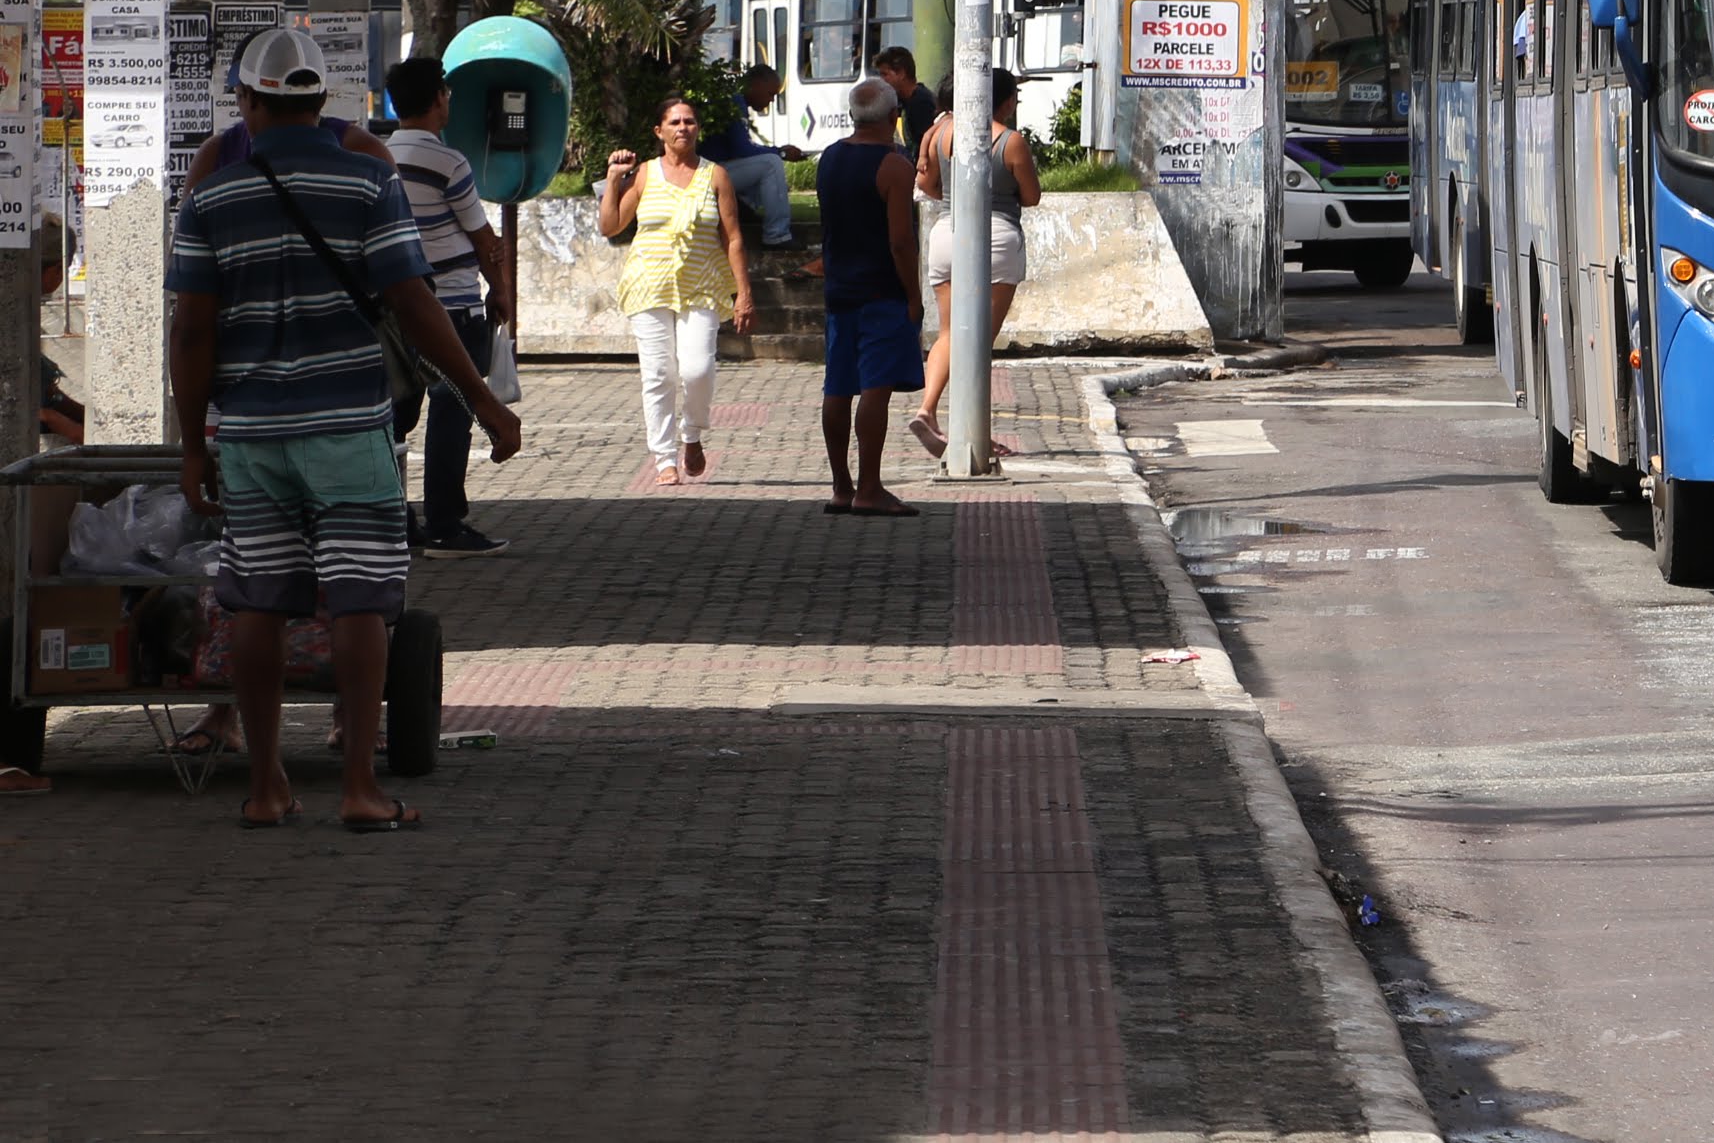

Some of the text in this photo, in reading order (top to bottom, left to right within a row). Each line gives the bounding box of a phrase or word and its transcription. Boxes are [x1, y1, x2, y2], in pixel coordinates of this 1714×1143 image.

[111, 6, 140, 14] CASA
[217, 7, 275, 23] EMPRÉSTIMO
[1158, 4, 1211, 19] PEGUE
[311, 17, 343, 25] COMPRE
[346, 15, 362, 23] SUA
[1142, 21, 1227, 37] R$1000
[1153, 42, 1215, 55] PARCELE
[108, 58, 163, 69] 3.500,00
[1136, 58, 1232, 72] 12X DE 113,33
[87, 76, 162, 86] 99854-8214
[1126, 76, 1242, 88] WWW.MSCREDITO.COM.BR
[87, 101, 157, 110] COMPRE SEU
[103, 114, 141, 122] CARRO
[107, 167, 154, 178] 290,00
